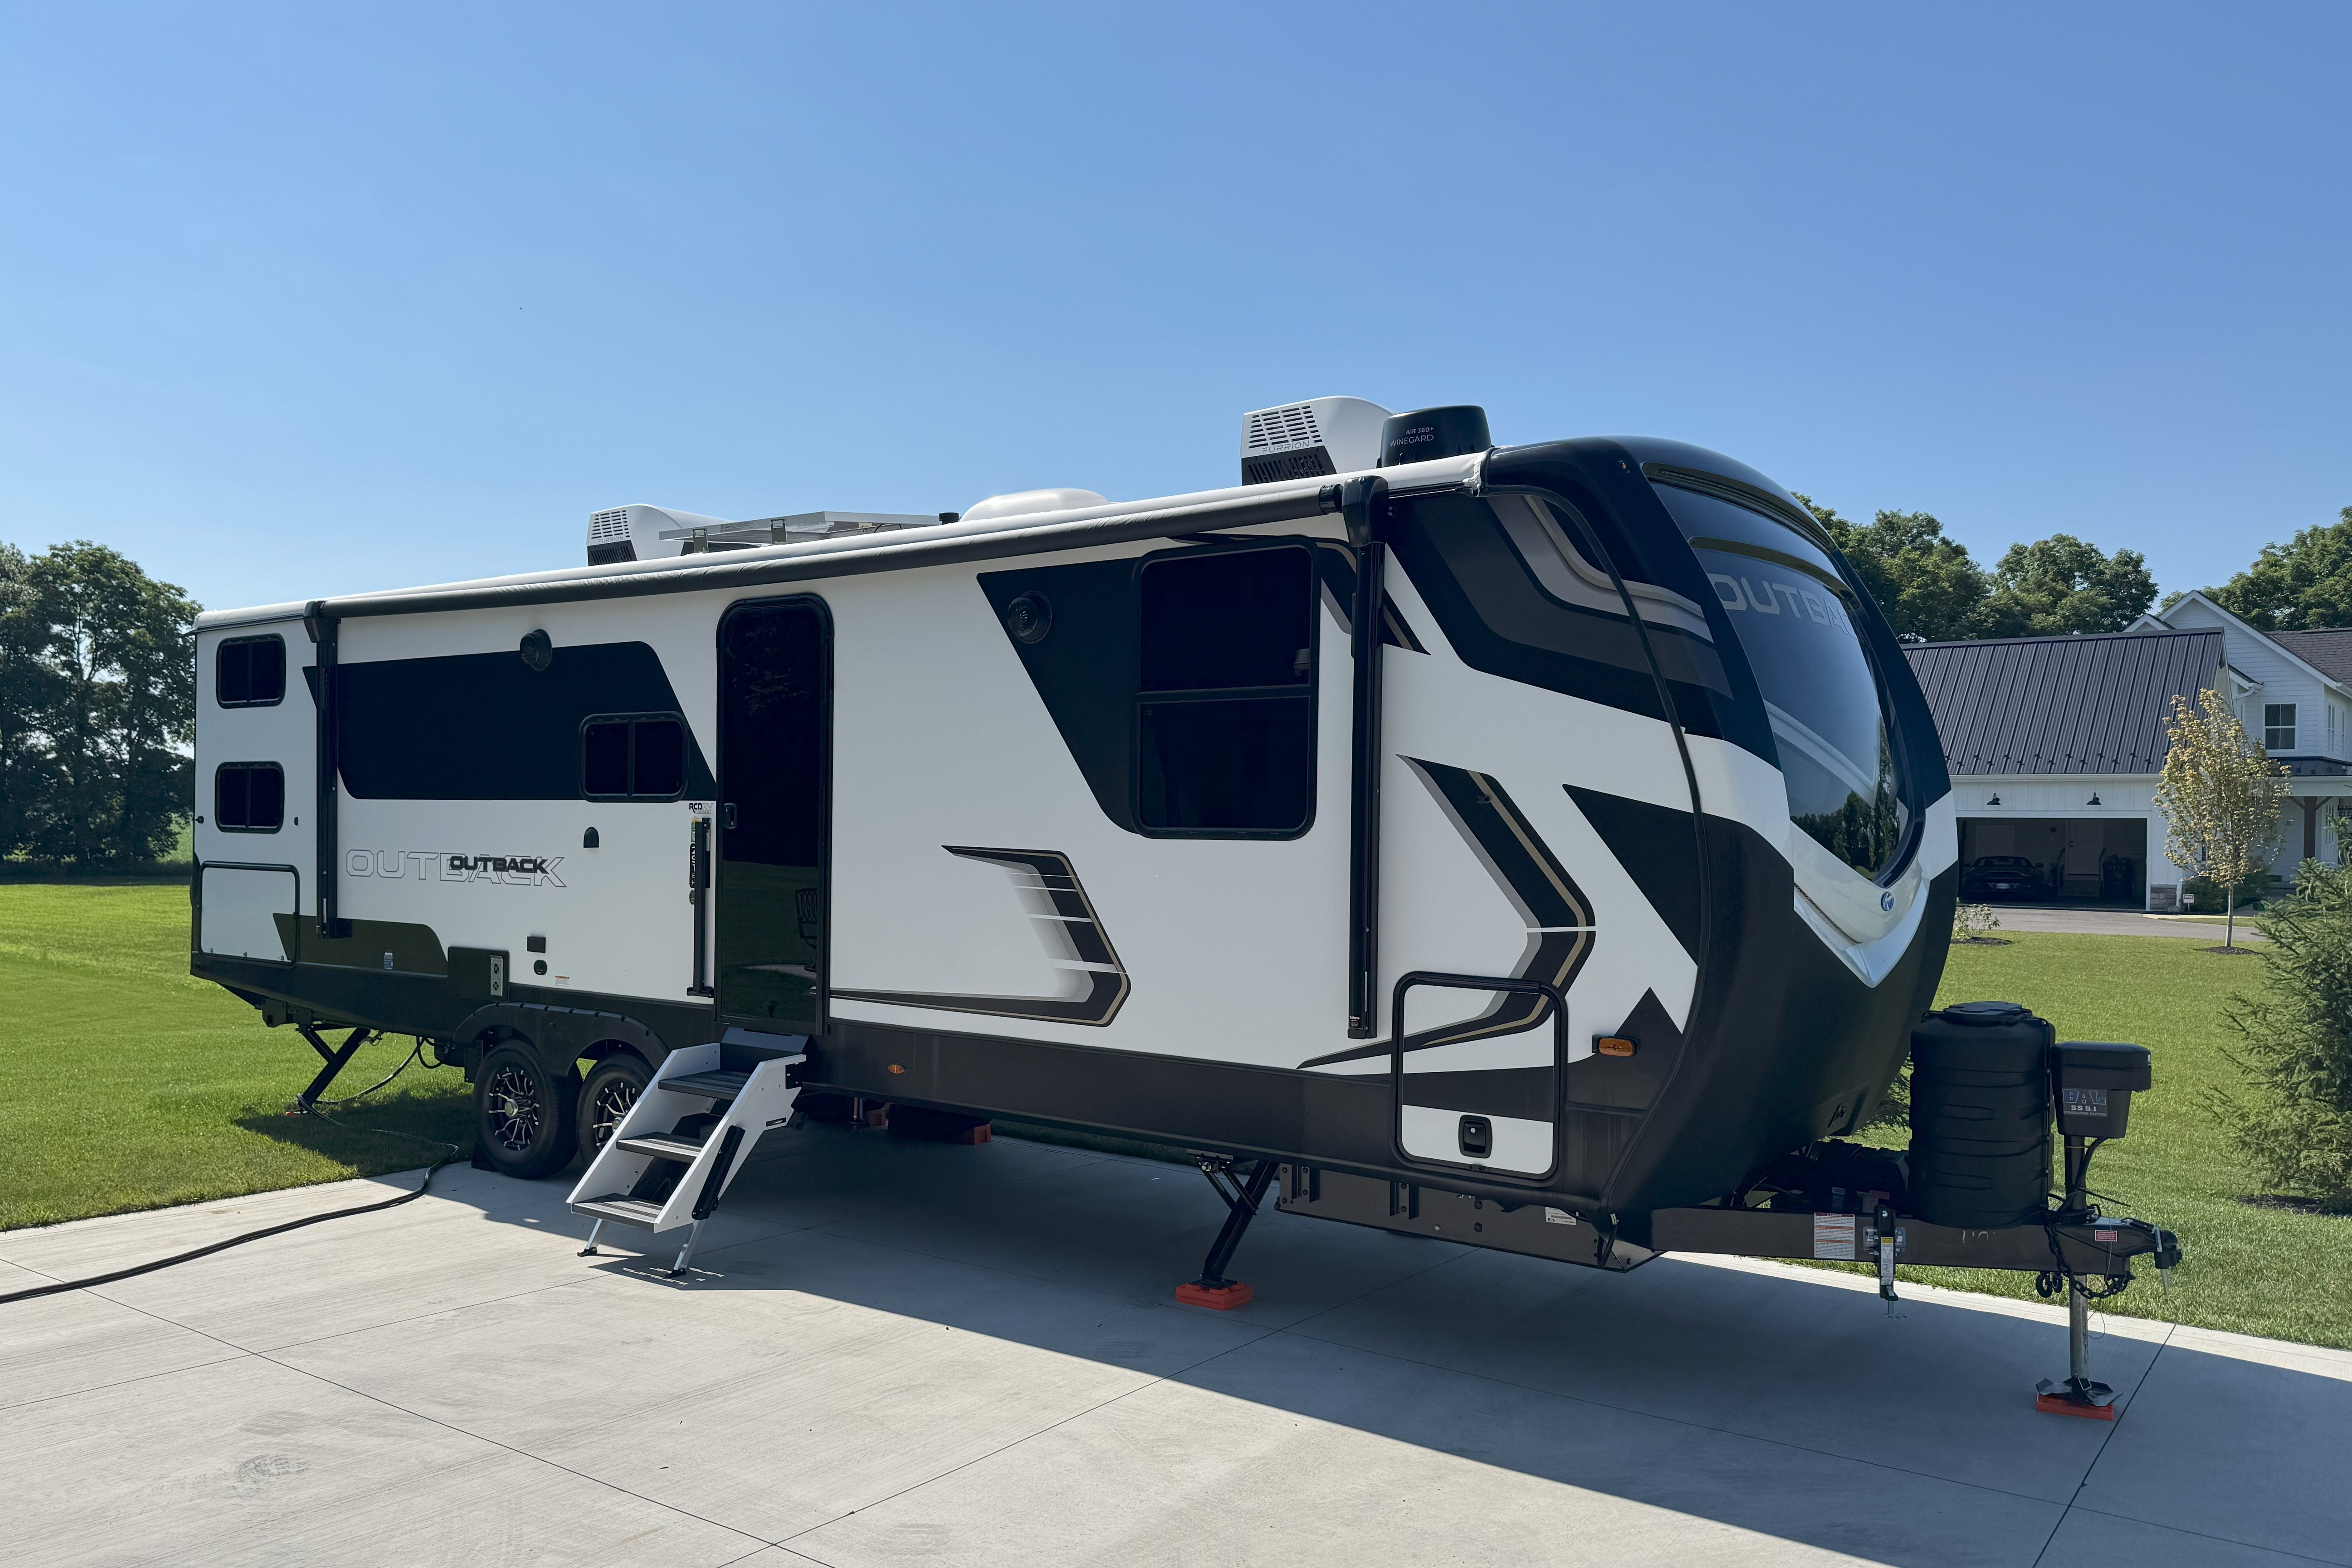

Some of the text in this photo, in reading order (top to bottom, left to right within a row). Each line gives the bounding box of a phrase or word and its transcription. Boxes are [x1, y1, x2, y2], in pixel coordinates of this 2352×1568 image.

[1262, 440, 1309, 454] FURRION
[1390, 434, 1434, 447] WINEGARD
[346, 849, 567, 887] OUTBACK
[449, 855, 549, 874] OUTBACK
